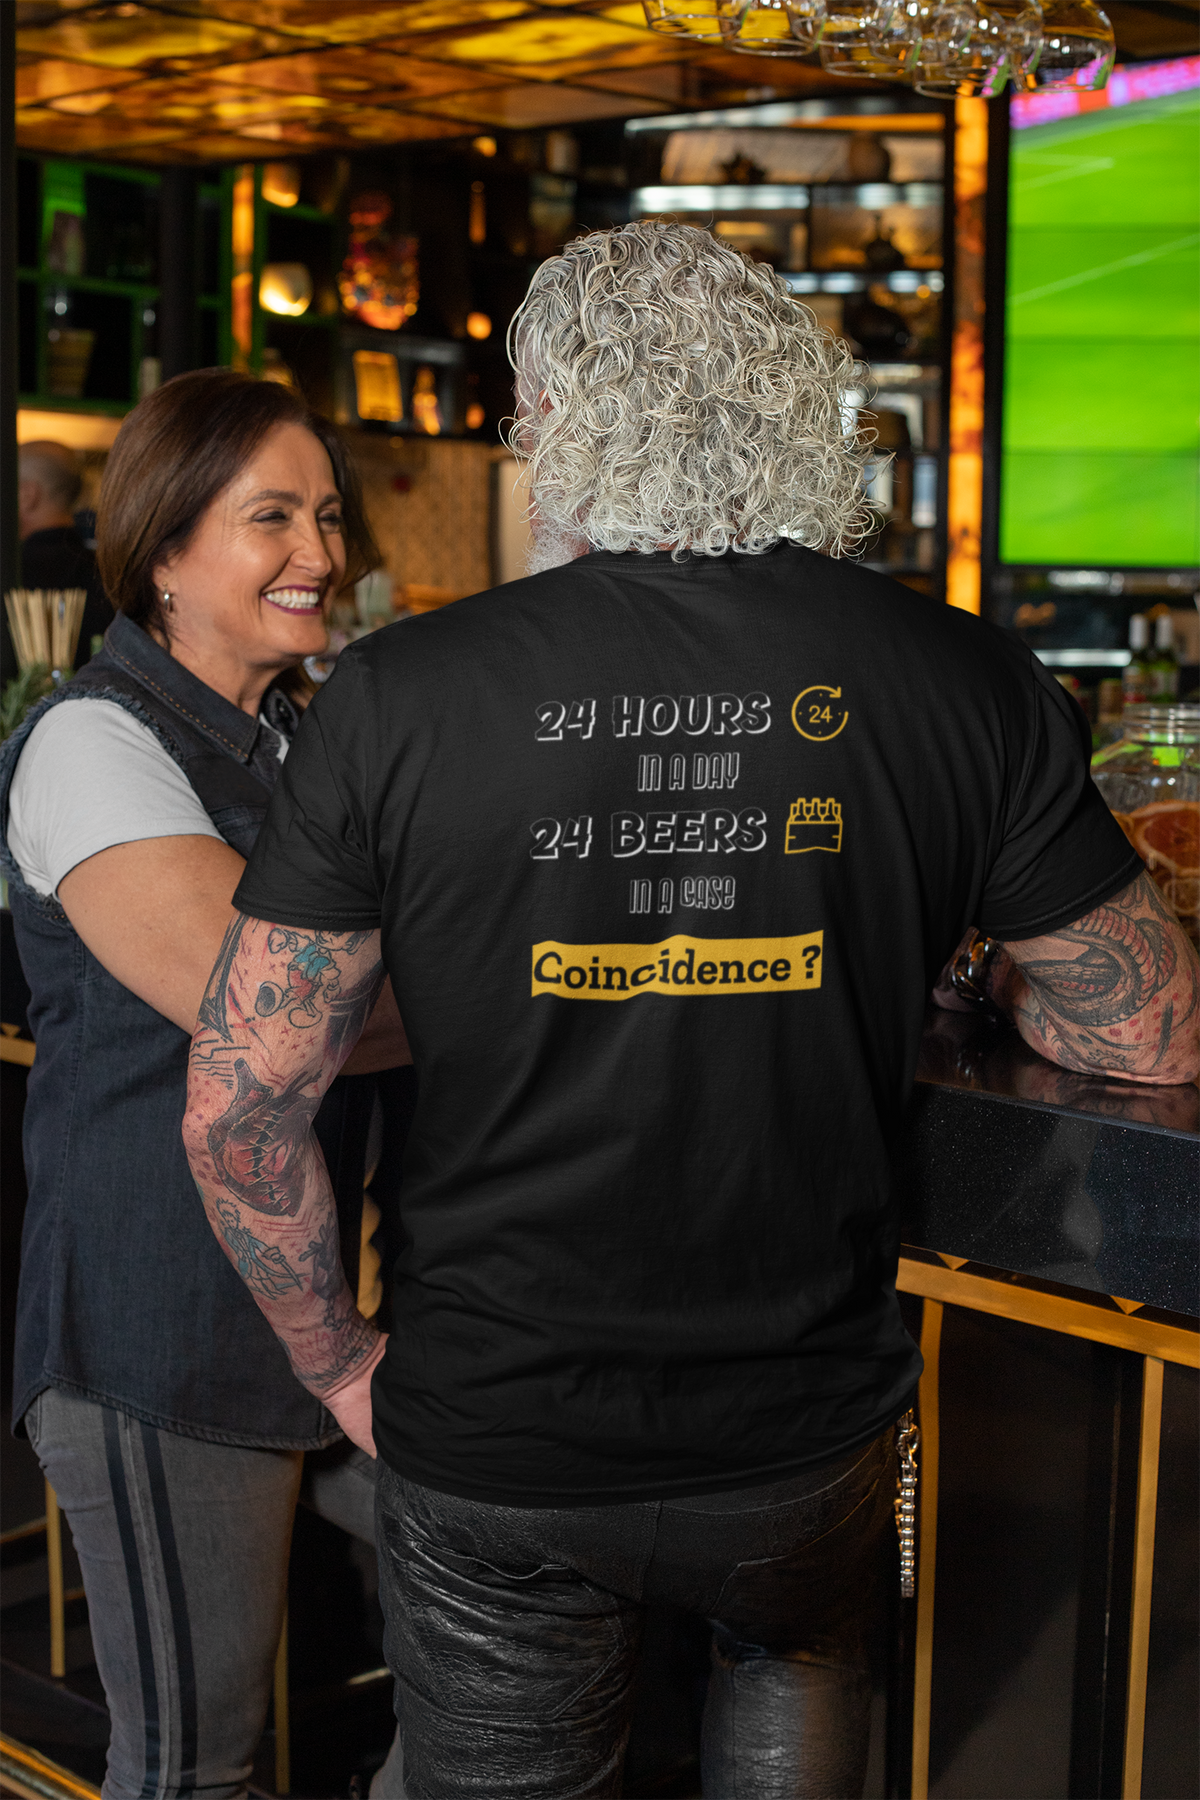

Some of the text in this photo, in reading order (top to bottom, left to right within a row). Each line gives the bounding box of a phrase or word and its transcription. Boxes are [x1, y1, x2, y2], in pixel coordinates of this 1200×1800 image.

[534, 692, 771, 742] 24 HOURS
[808, 705, 833, 724] 24
[637, 752, 740, 792] IN A DAY
[530, 807, 768, 860] 24 BEERS
[629, 879, 651, 914] IN
[657, 878, 674, 914] A
